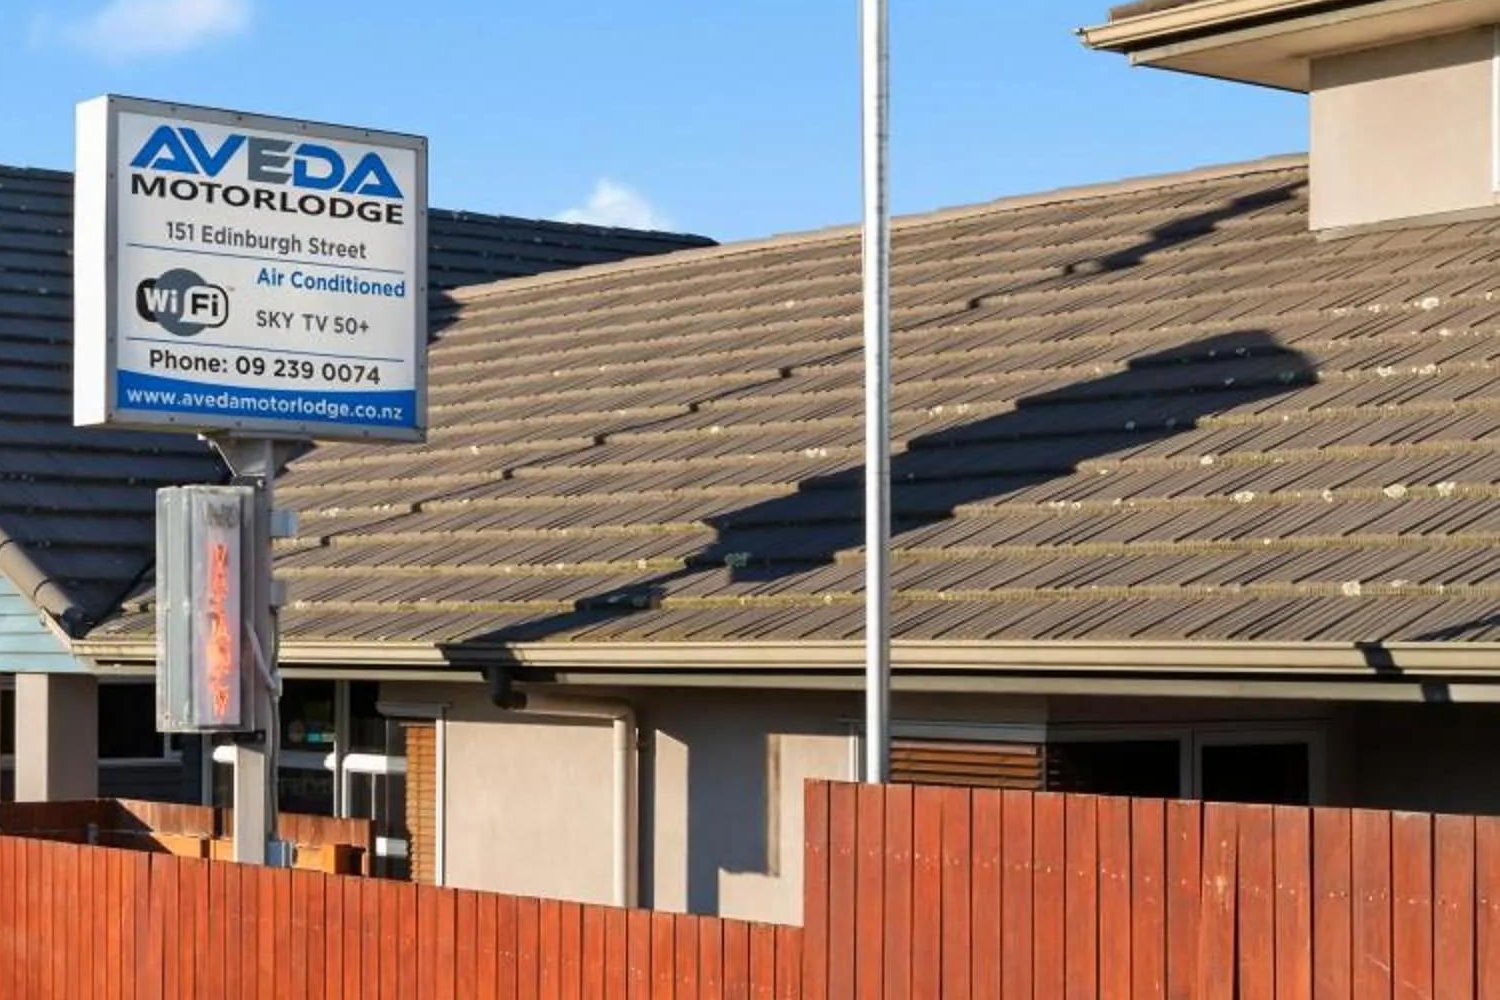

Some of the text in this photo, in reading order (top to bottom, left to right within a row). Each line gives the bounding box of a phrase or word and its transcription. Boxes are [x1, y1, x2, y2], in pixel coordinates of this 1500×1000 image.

[130, 124, 404, 199] AVEDA
[131, 173, 404, 225] MOTORLODGE
[166, 221, 367, 260] 151 Edinburgh Street
[257, 267, 405, 298] Air Conditioned
[256, 309, 370, 335] SKY TV 50+
[149, 349, 381, 385] Phone: 09 239 0074
[126, 387, 403, 421] www.avedamotorlodge.co.nz
